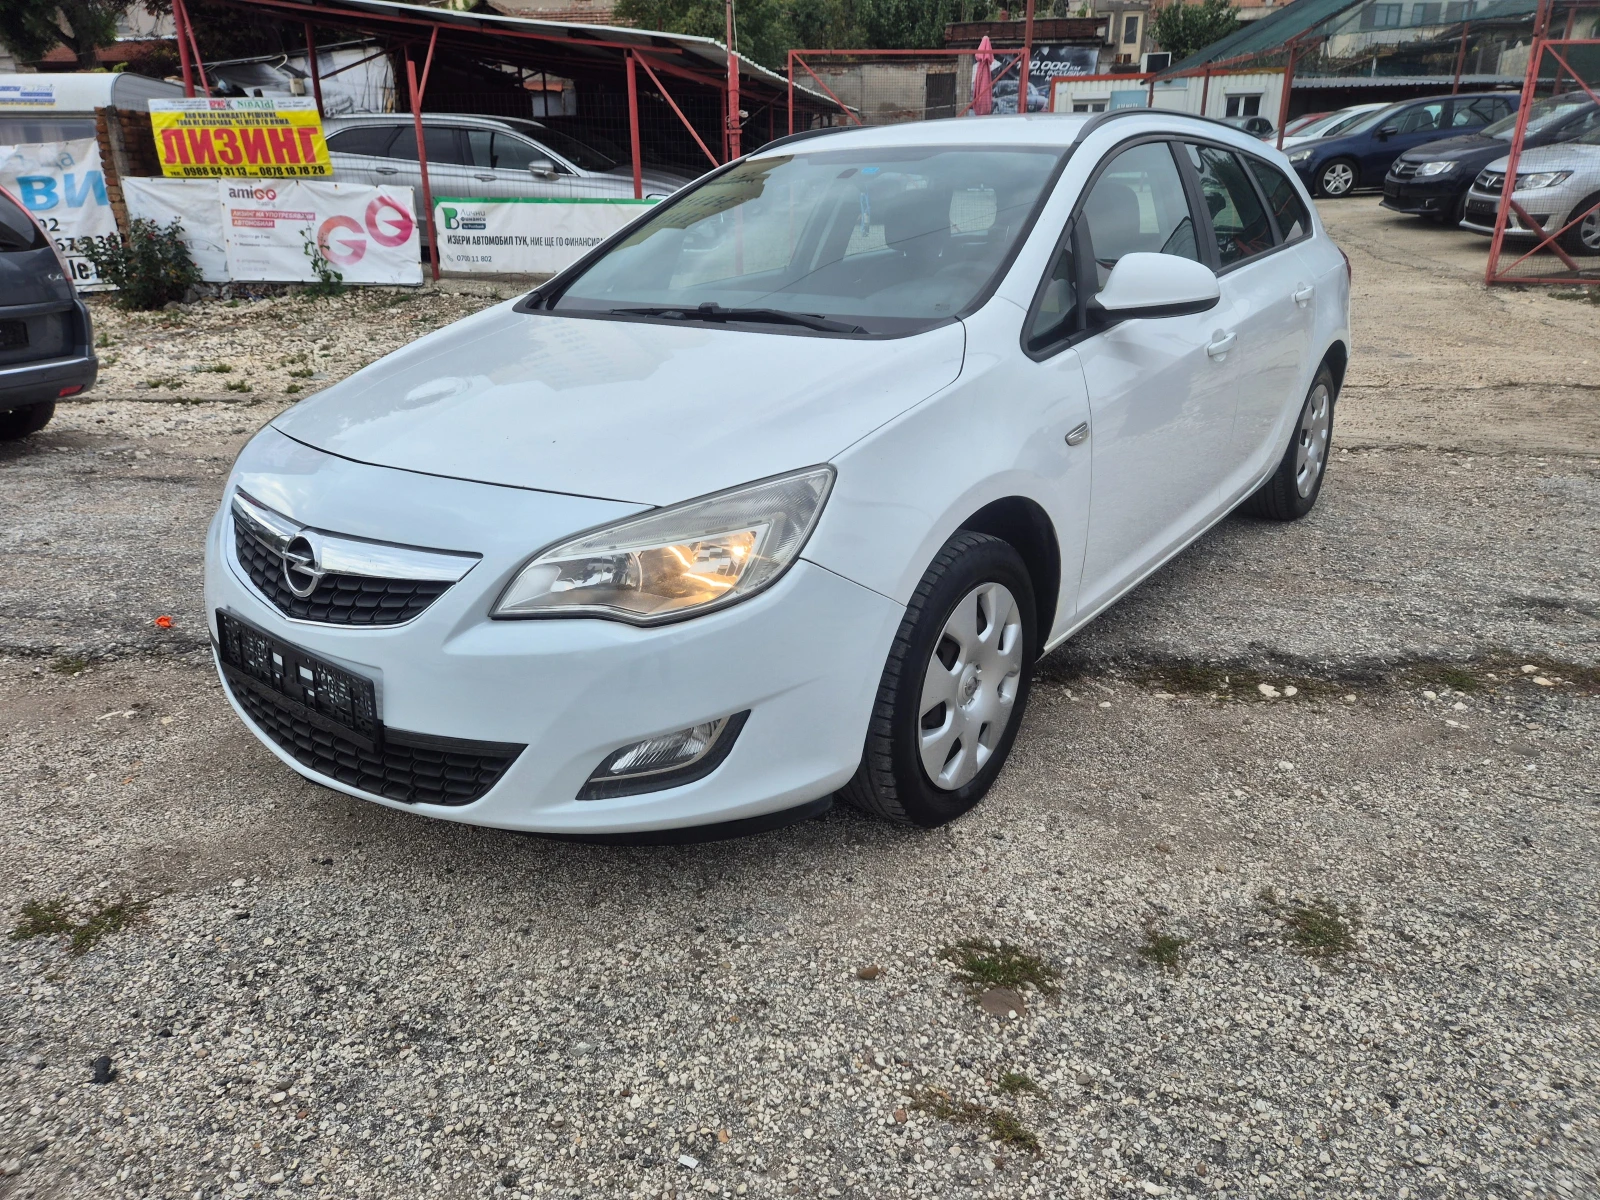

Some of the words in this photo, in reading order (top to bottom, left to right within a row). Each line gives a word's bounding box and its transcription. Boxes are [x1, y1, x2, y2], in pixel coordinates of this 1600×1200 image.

[1041, 61, 1071, 71] 000
[161, 127, 318, 165] ЛИЗИНГ
[183, 166, 209, 176] 0988
[210, 166, 222, 175] 84
[224, 166, 235, 176] 31
[236, 166, 247, 175] 13
[259, 166, 283, 176] 0878
[285, 167, 297, 175] 18
[298, 166, 310, 175] 78
[311, 165, 325, 175] 28
[228, 186, 277, 201] amiGO
[447, 235, 471, 246] ИЗБЕРИ
[472, 236, 513, 246] АВТОМОБИЛ
[514, 236, 529, 247] ТУК,
[530, 237, 543, 246] НИЕ
[544, 237, 555, 247] ЩЕ
[556, 237, 564, 247] ГО
